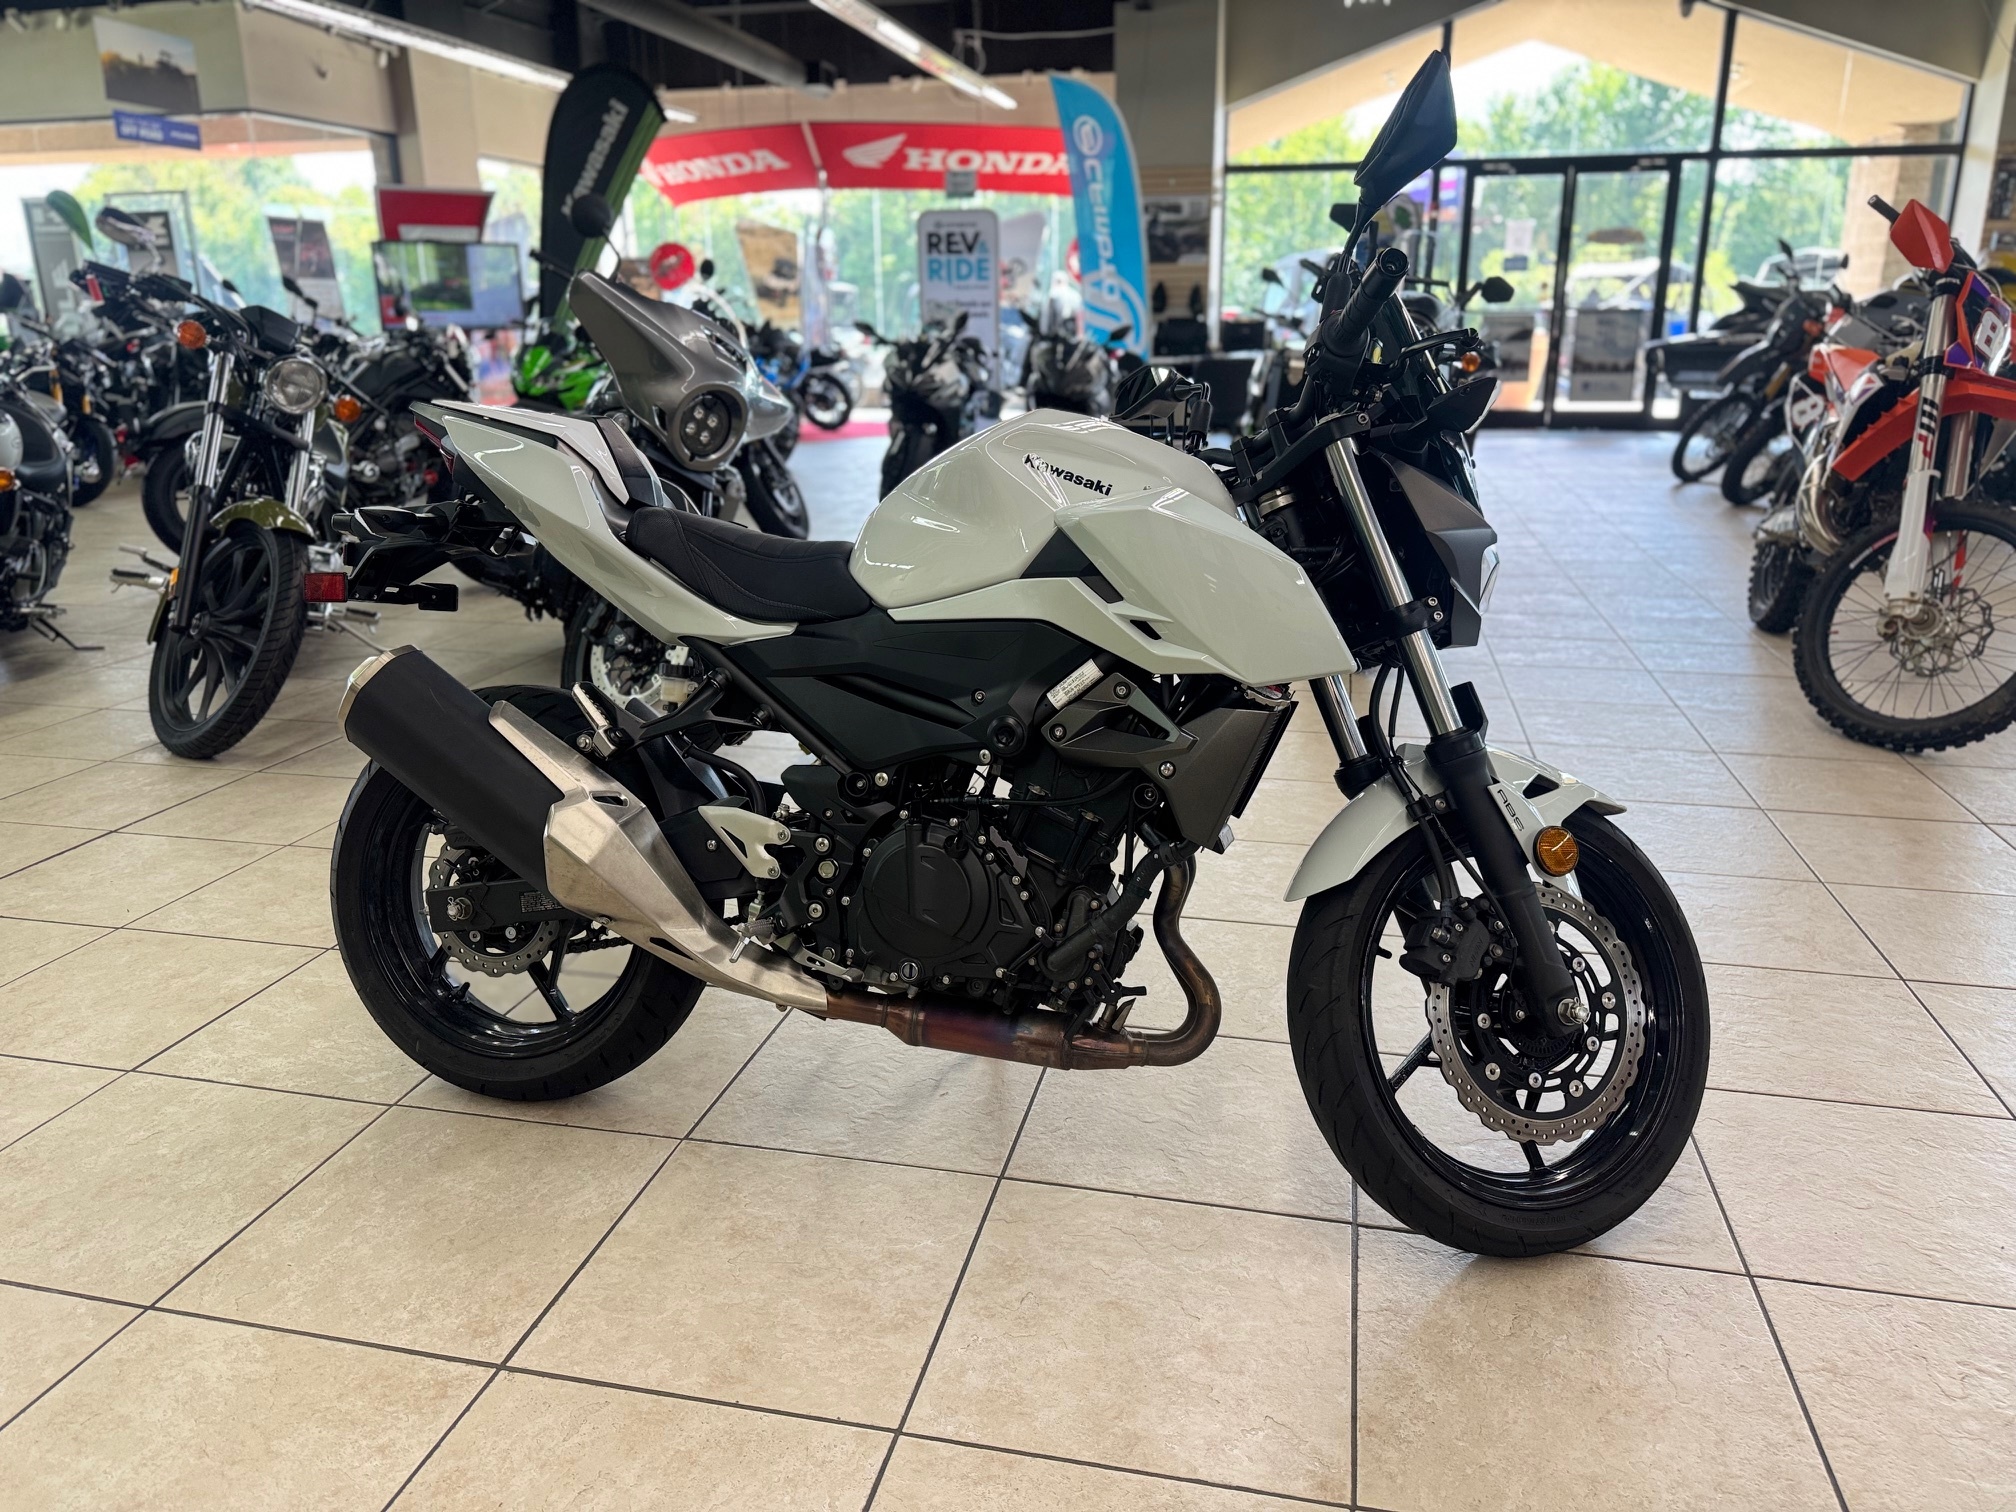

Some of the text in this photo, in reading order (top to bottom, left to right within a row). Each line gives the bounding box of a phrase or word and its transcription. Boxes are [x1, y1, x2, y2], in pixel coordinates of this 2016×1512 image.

[655, 148, 791, 186] HONDA
[903, 147, 1070, 176] HONDA
[927, 231, 981, 255] REV
[928, 258, 991, 286] RIDE
[1023, 453, 1113, 496] Kawasaki
[1497, 789, 1525, 831] ABS
